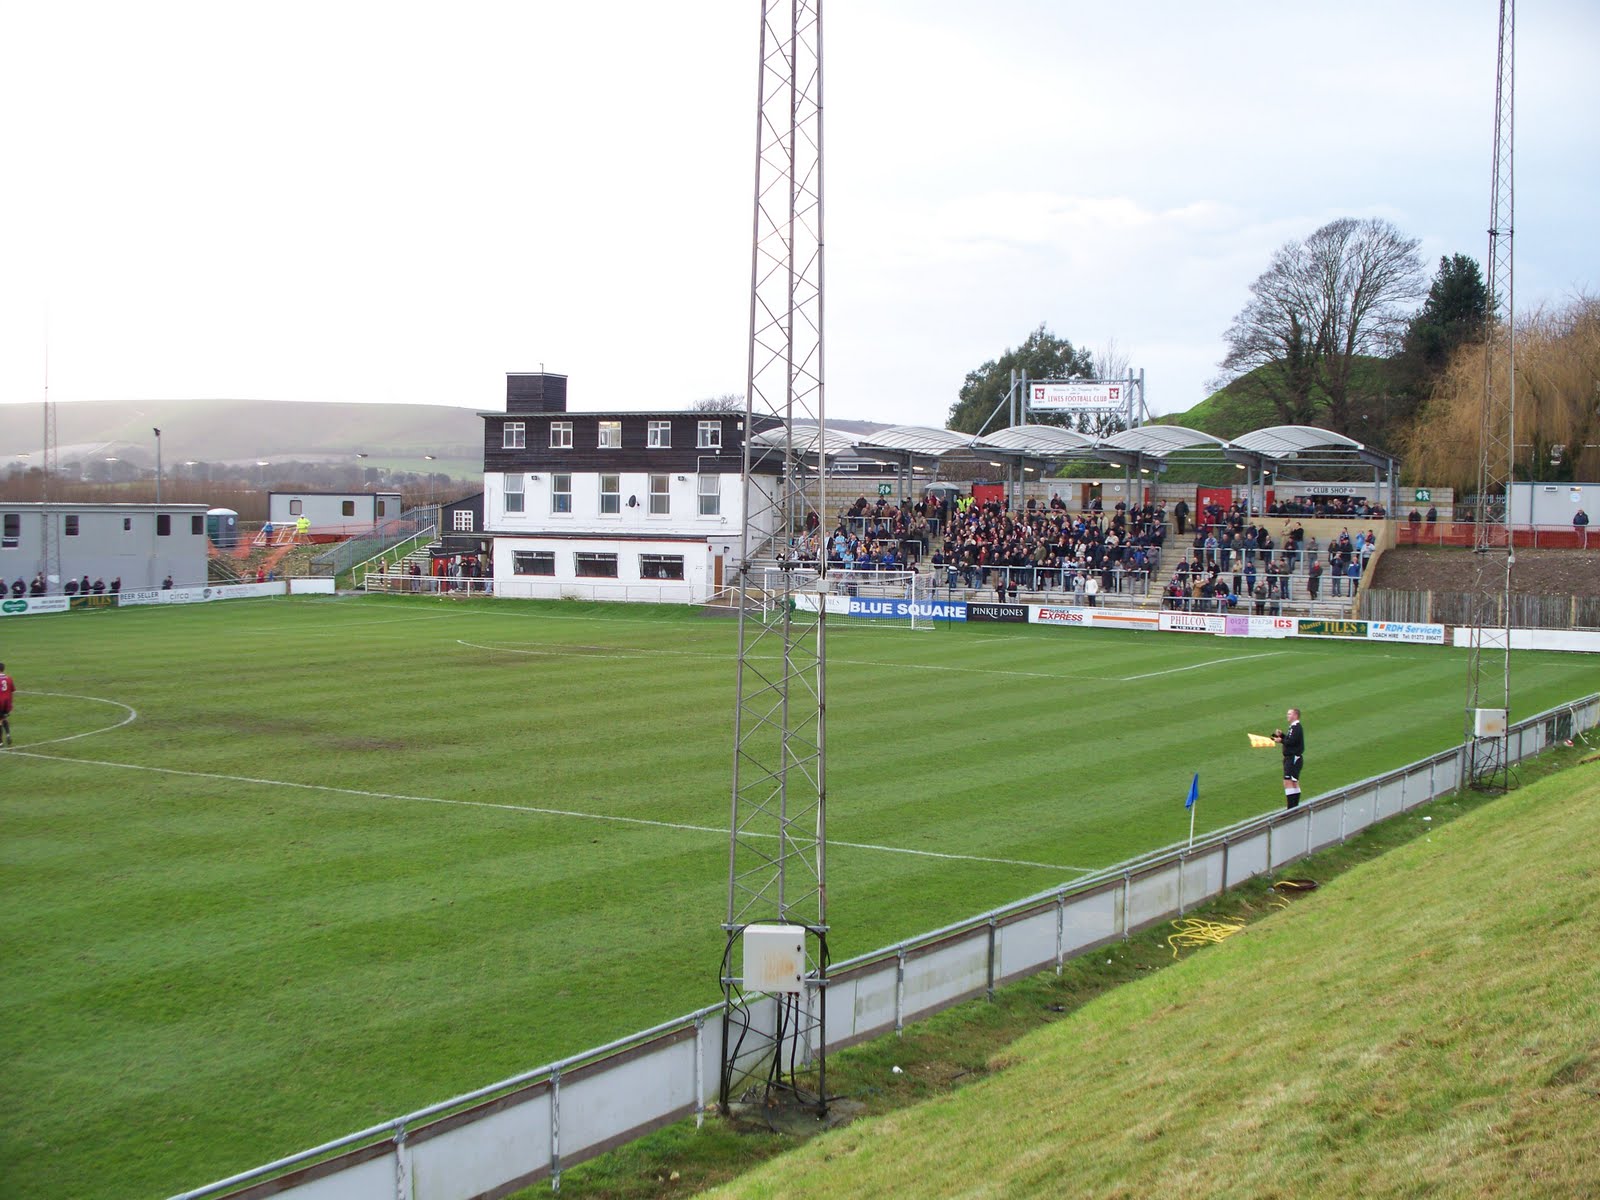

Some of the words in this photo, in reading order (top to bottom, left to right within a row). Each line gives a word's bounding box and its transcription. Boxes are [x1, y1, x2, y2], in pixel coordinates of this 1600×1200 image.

[1047, 395, 1064, 403] LEWES
[1065, 395, 1092, 403] FOOTBALL
[120, 592, 136, 600] BEER
[137, 591, 159, 599] SELLER
[850, 601, 893, 615] BLUE
[896, 603, 967, 618] SQUARE
[972, 607, 999, 619] PINKIE
[999, 607, 1024, 617] JONES
[1170, 615, 1206, 626] PHILCOX
[1273, 619, 1293, 628] ICS
[1323, 621, 1358, 633] TILES
[1385, 623, 1404, 633] RDH
[1405, 624, 1442, 635] Services
[1, 680, 8, 691] 3
